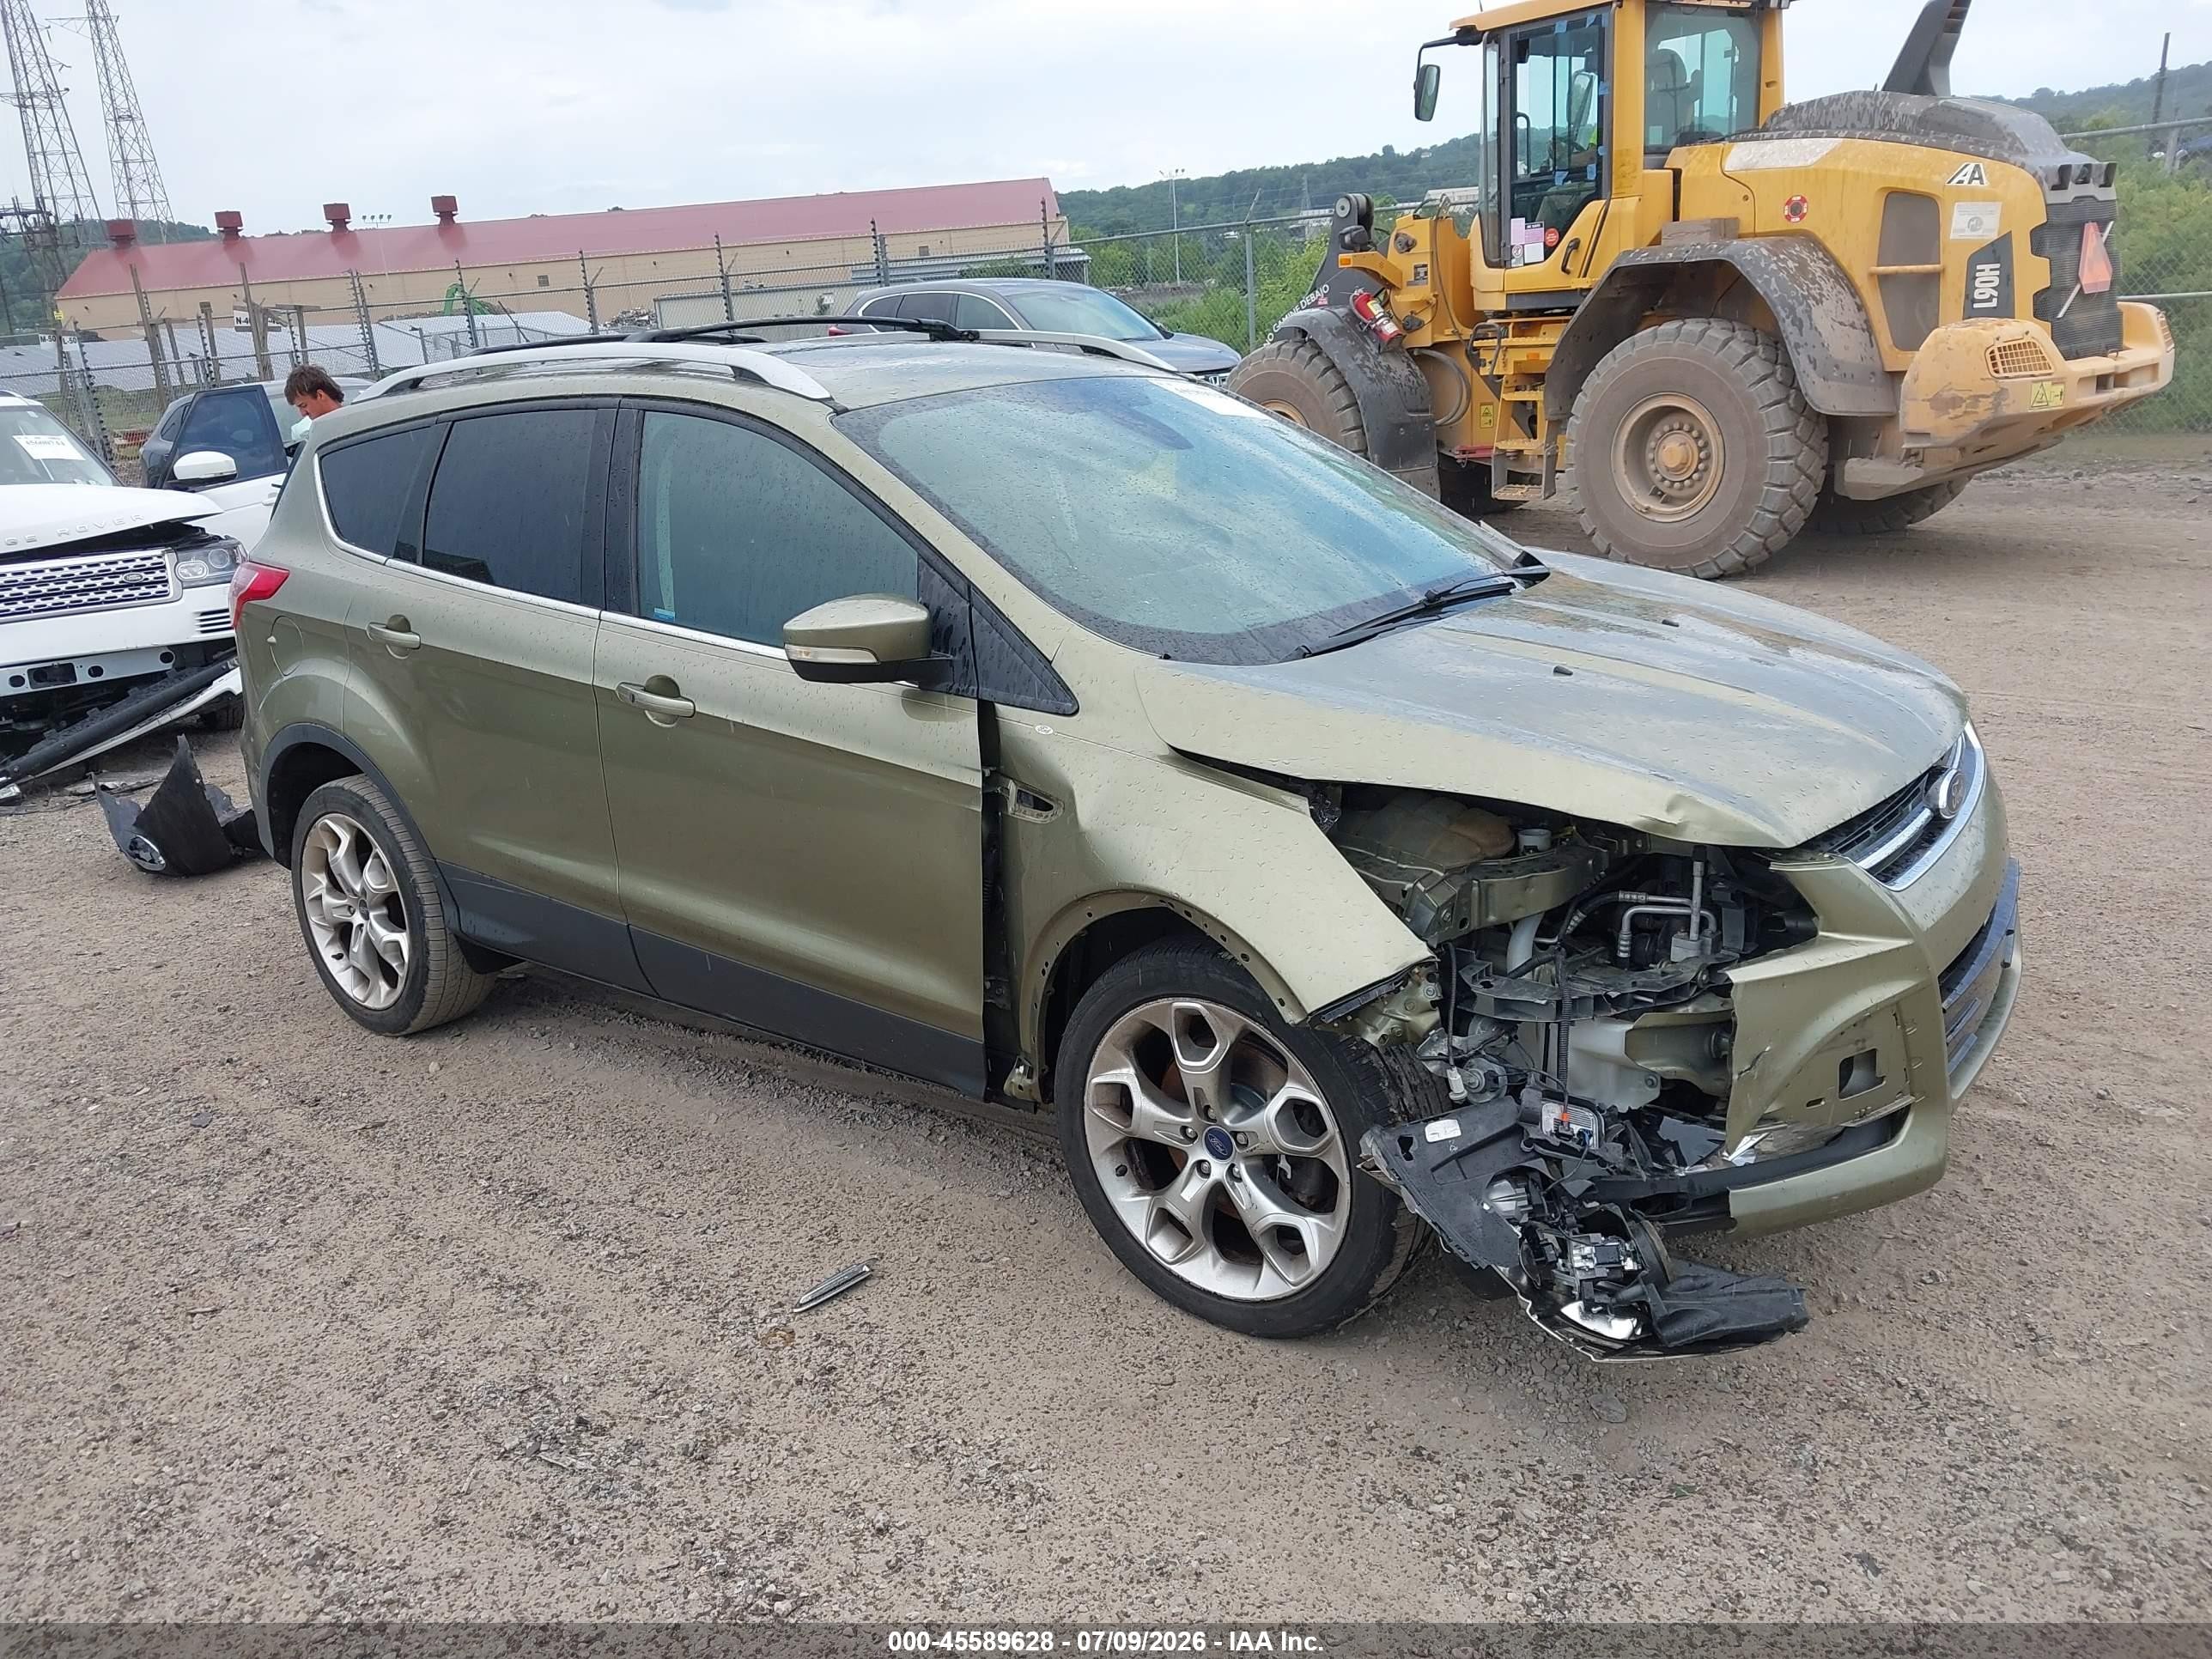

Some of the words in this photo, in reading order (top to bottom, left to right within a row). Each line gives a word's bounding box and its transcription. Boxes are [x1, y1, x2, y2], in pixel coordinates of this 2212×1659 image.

[1300, 284, 1330, 310] DEBAJO
[1973, 264, 2001, 308] L90H
[235, 316, 249, 325] N-4
[63, 337, 77, 345] L-50
[56, 514, 145, 538] ROVER
